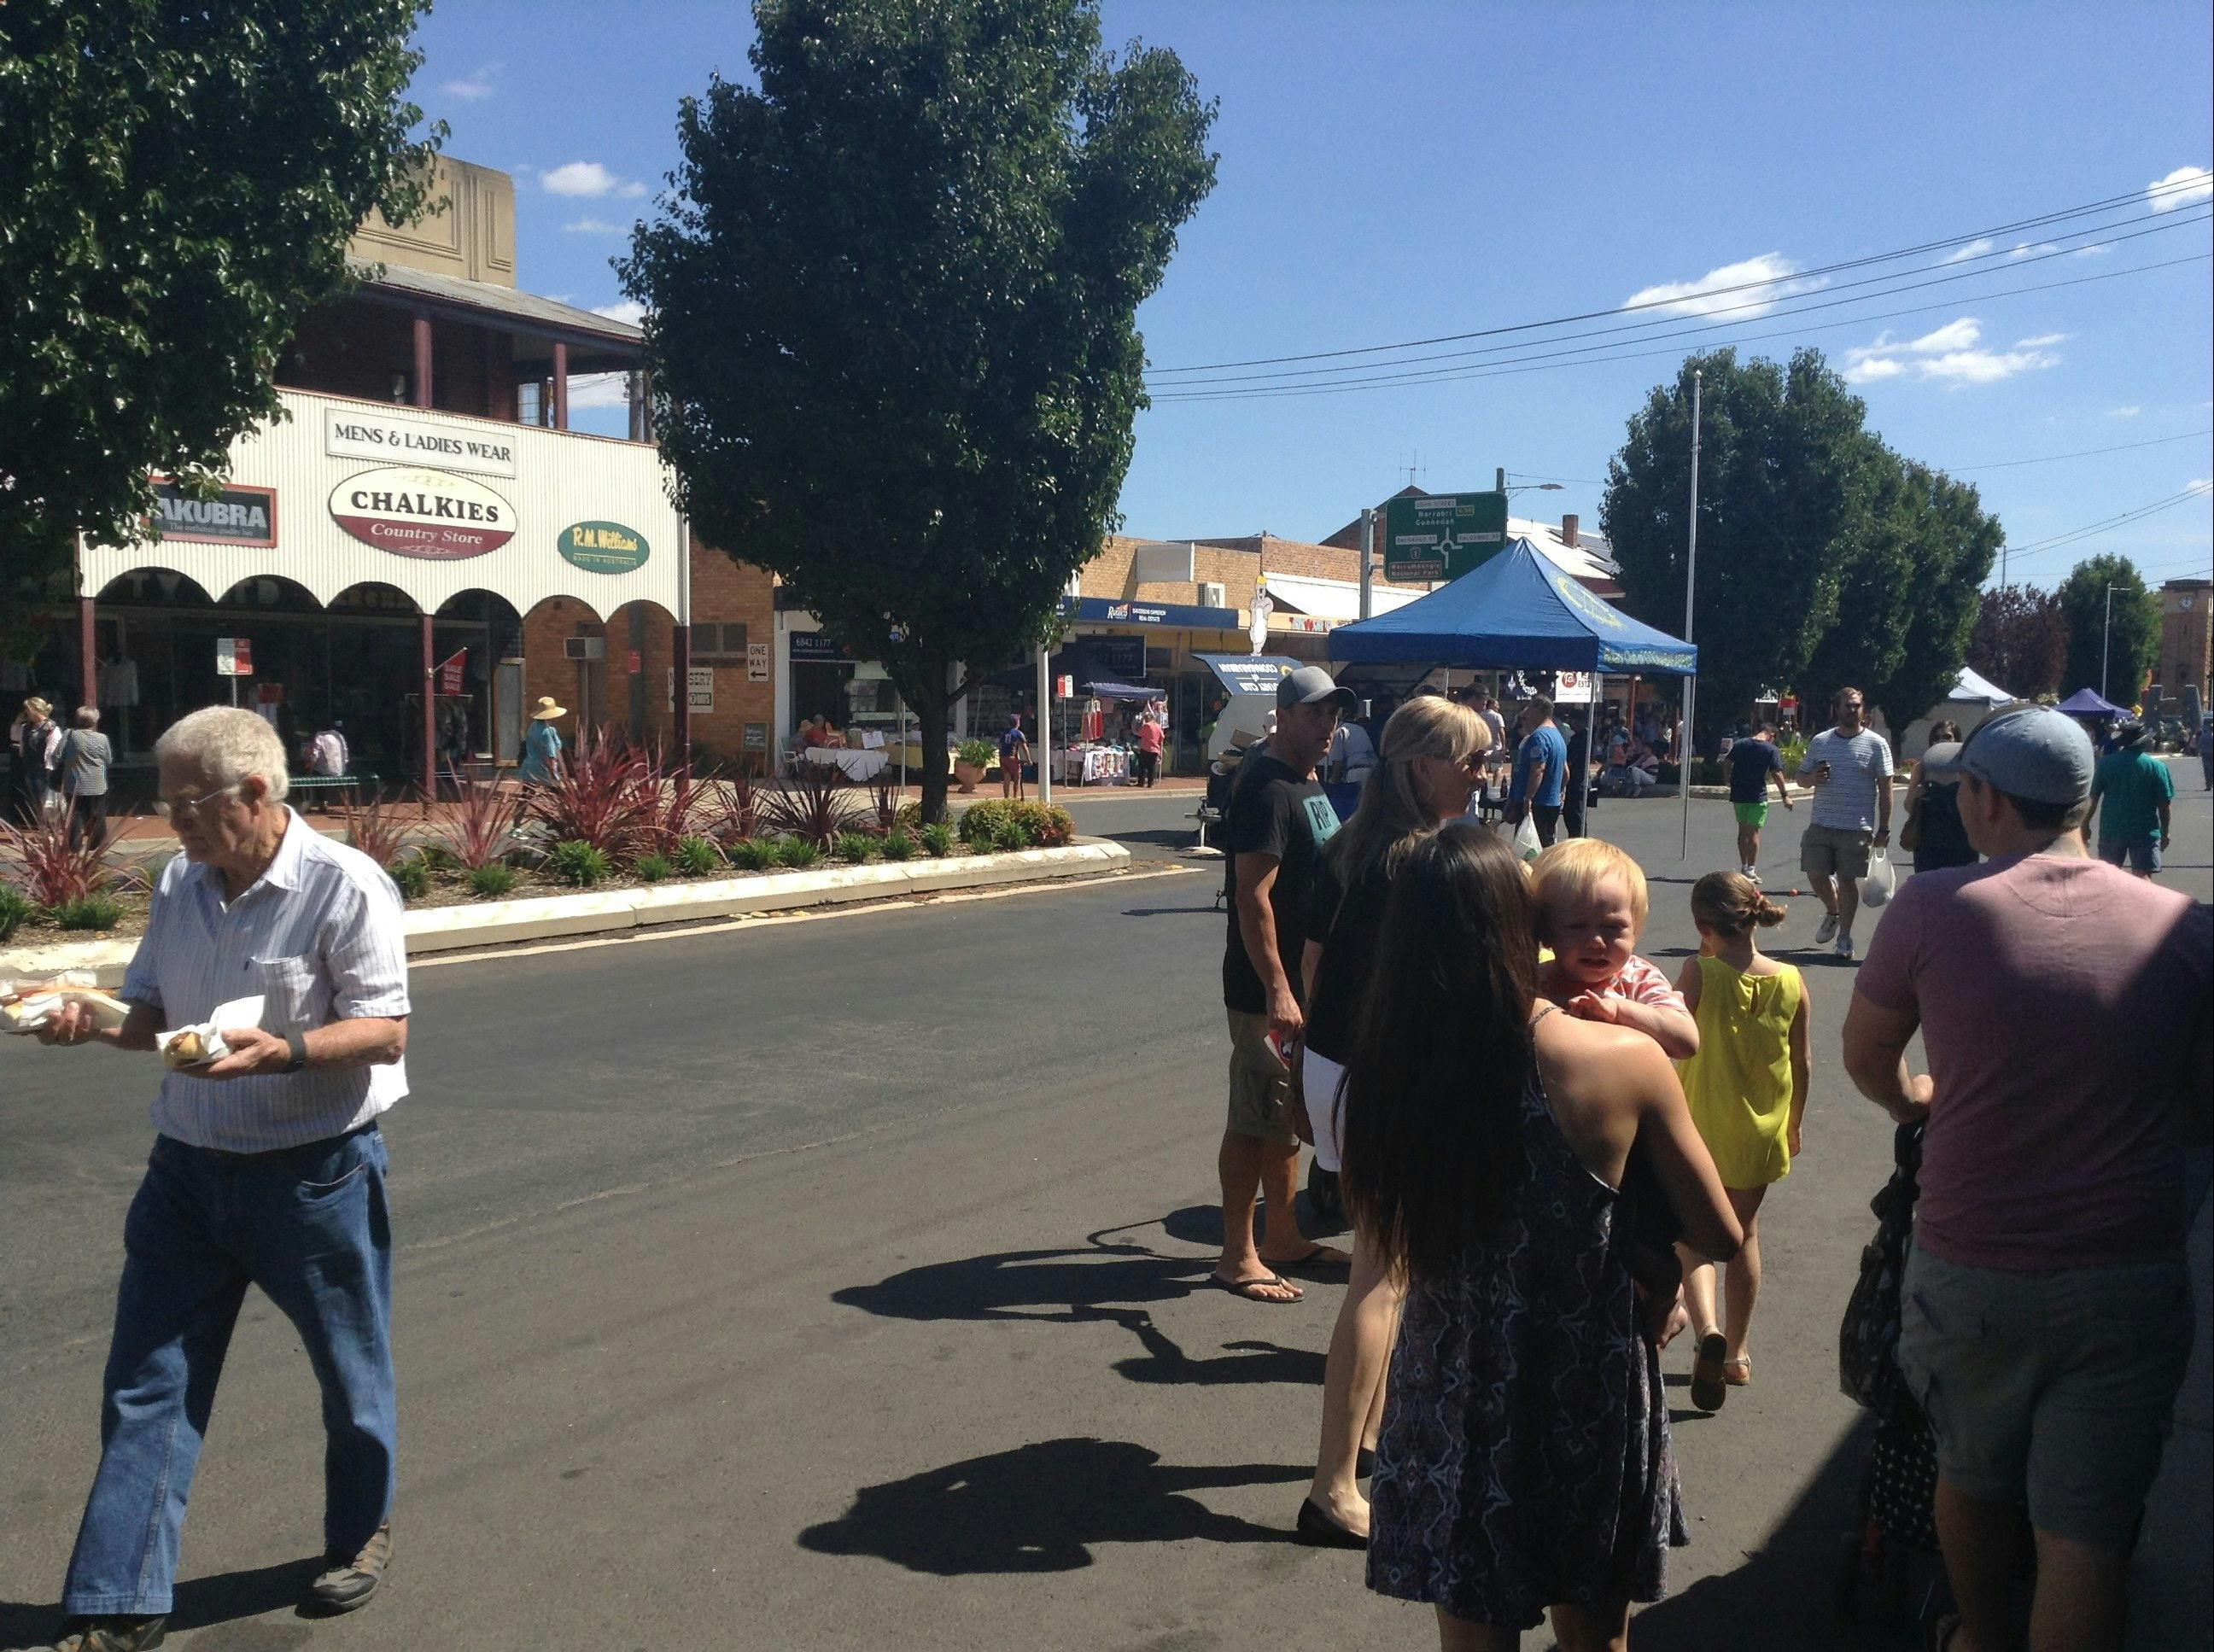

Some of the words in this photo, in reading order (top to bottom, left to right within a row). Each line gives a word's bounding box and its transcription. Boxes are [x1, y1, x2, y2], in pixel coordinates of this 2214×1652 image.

[335, 423, 383, 444] MENS
[388, 430, 400, 447] &
[405, 433, 463, 455] LADIES
[466, 441, 511, 462] WEAR
[155, 496, 267, 528] AKUBRA
[350, 490, 499, 522] CHALKIES
[1417, 510, 1452, 518] Narrabri
[371, 523, 438, 542] Country
[441, 530, 483, 545] Store
[750, 645, 767, 656] ONE
[749, 658, 767, 668] WAY
